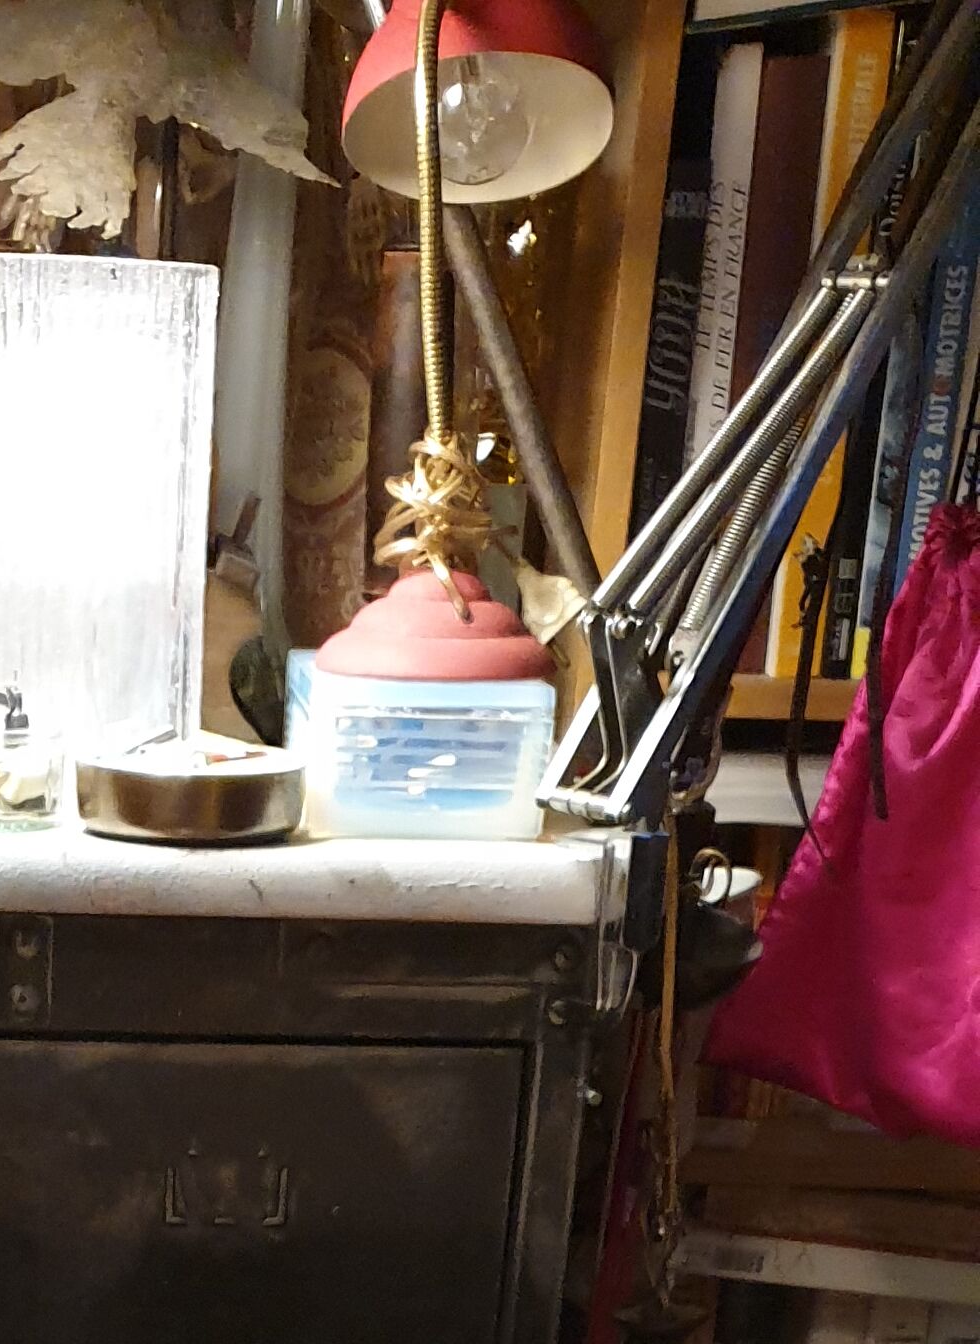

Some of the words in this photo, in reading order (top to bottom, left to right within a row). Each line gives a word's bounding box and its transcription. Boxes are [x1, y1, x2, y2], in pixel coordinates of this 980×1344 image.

[707, 182, 724, 228] DES
[723, 180, 748, 278] FRANCE
[700, 236, 720, 314] TEMPS
[719, 288, 737, 318] EN
[715, 326, 734, 370] FER
[711, 379, 728, 410] DE
[923, 443, 944, 461] &
